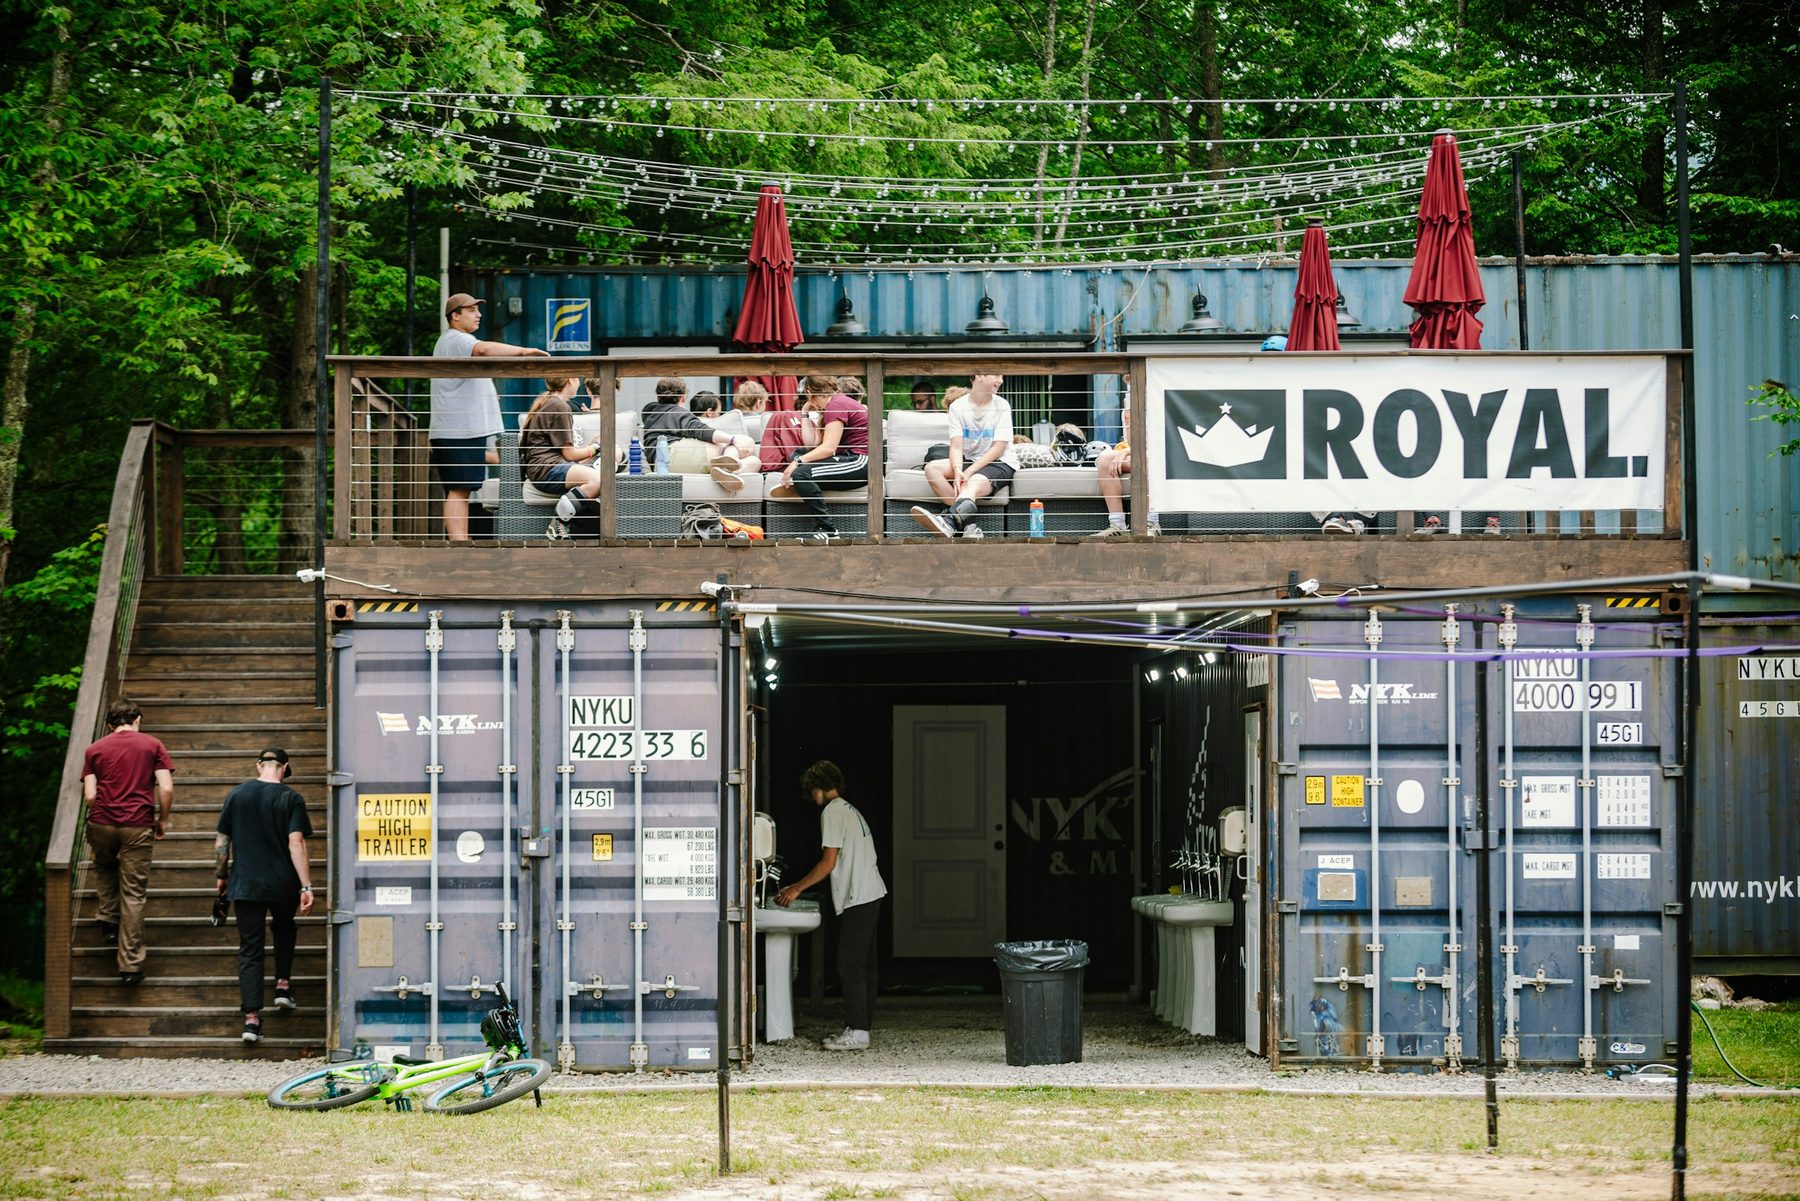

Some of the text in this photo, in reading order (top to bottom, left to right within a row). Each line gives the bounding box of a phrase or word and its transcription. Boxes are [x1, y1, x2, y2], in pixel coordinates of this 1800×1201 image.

[1516, 651, 1574, 677] NYKU
[1349, 683, 1413, 699] NYK
[572, 698, 632, 724] NYKU
[416, 714, 478, 731] NYK
[1600, 725, 1640, 742] 45G1
[574, 790, 611, 807] 45G1
[364, 799, 427, 816] CAUTION
[378, 818, 411, 836] HIGH
[364, 838, 427, 856] TRAILER
[1049, 851, 1078, 876] &
